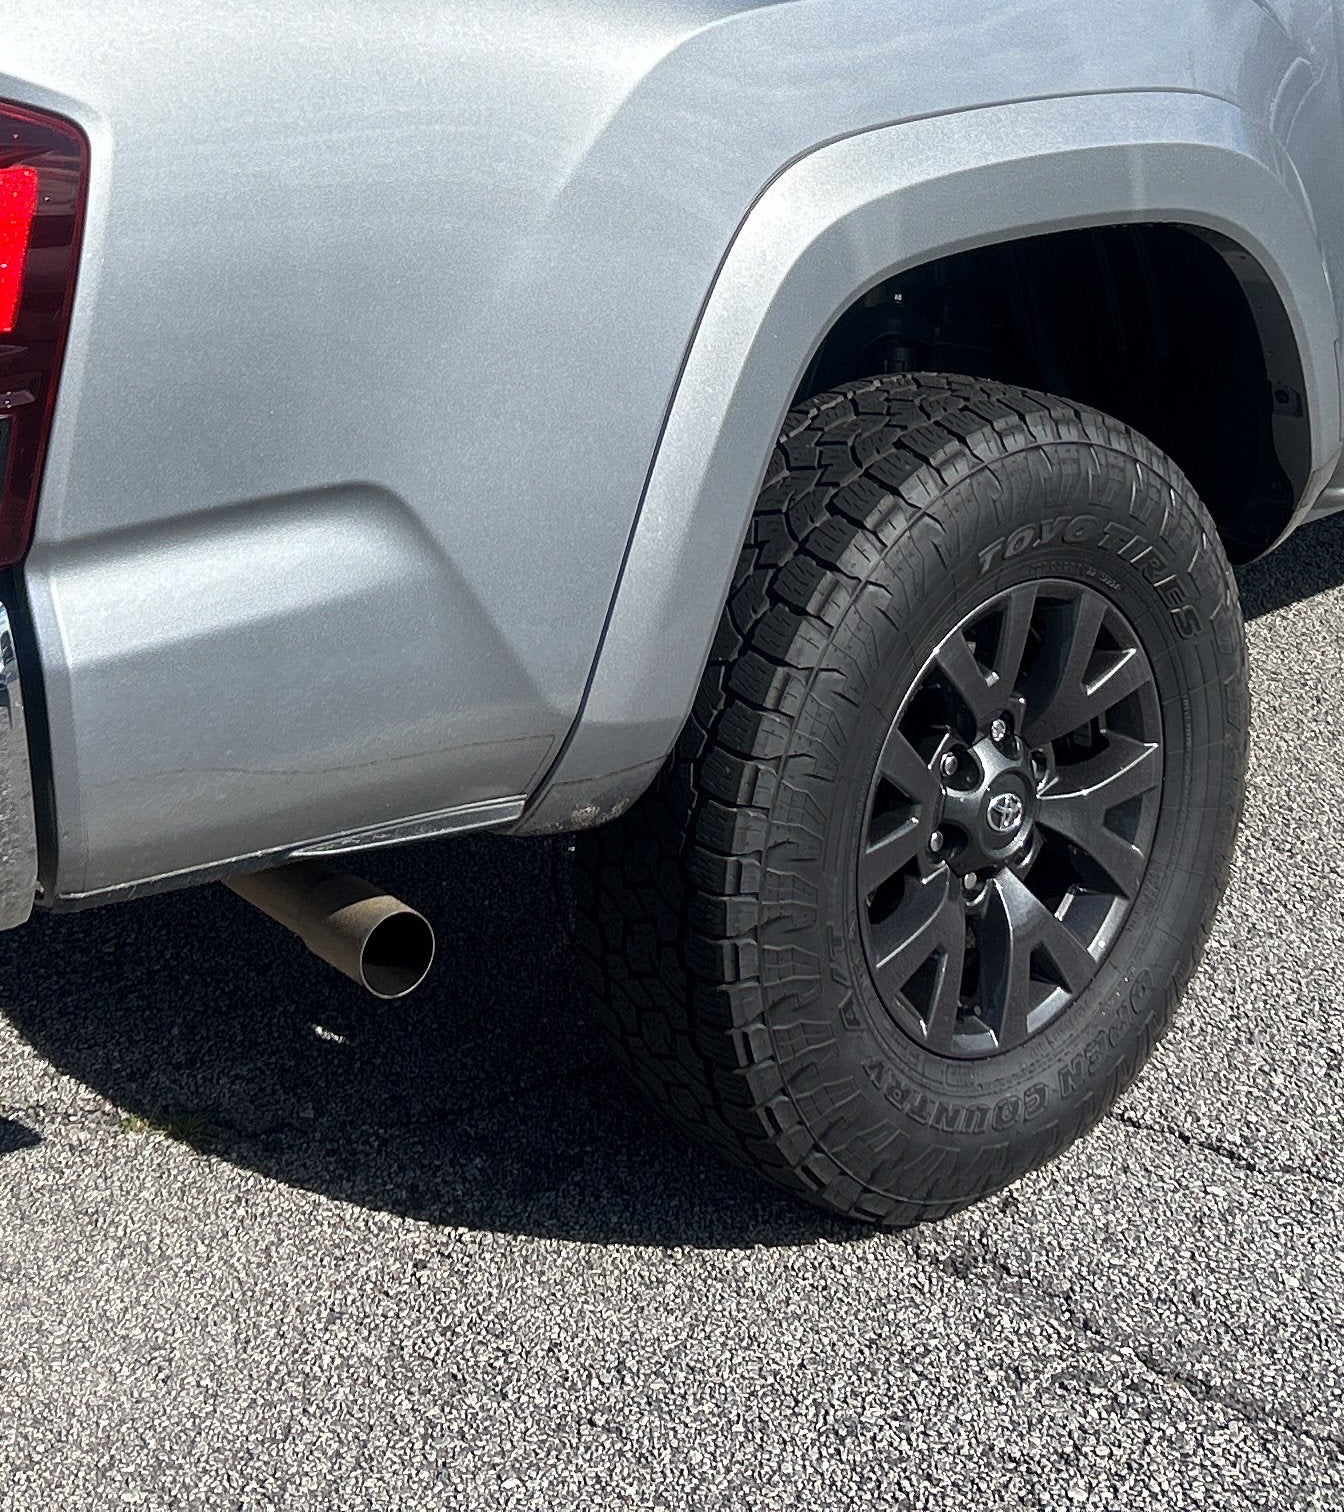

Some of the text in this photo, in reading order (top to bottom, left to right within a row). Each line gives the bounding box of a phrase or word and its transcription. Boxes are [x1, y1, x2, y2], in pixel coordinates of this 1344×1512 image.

[978, 515, 1202, 640] TOYO TIRES
[860, 1057, 1050, 1134] COUNTRY
